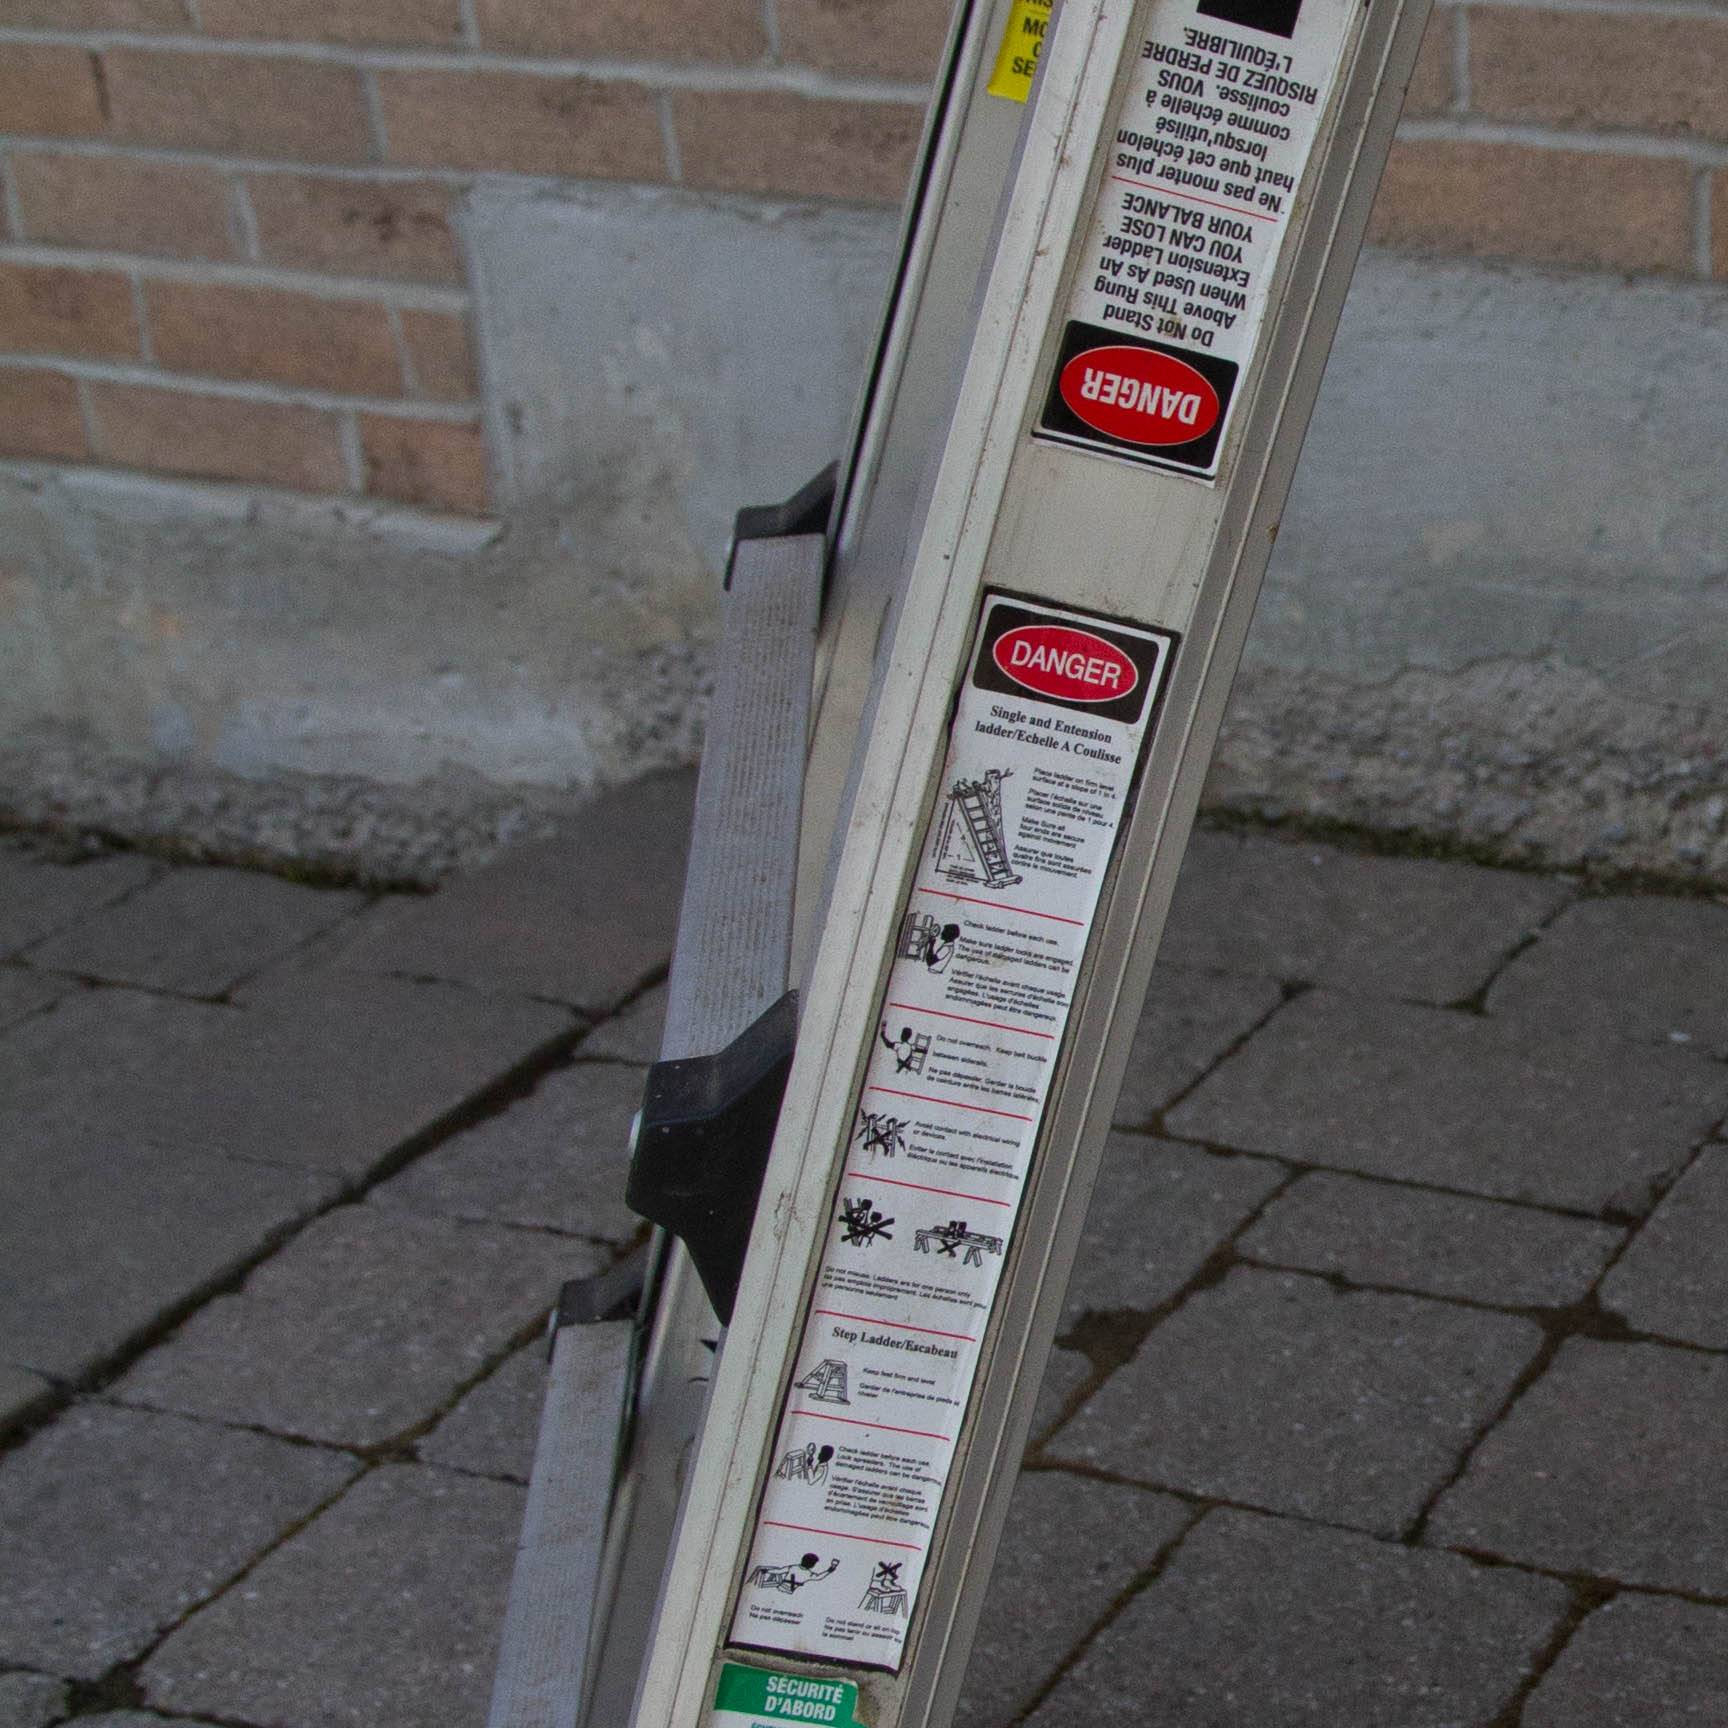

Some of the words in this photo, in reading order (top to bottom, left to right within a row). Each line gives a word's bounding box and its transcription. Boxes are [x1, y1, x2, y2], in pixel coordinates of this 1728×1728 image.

[1140, 39, 1213, 75] PERDRE
[1182, 26, 1293, 74] L'ÉQUILIBRE.
[1156, 68, 1204, 98] VOUS
[1214, 60, 1241, 83] DE
[1242, 68, 1318, 103] RISQUEZ
[1144, 88, 1157, 108] à
[1160, 93, 1223, 126] échelle
[1215, 84, 1290, 117] coulisse.
[1154, 115, 1268, 162] lorsqu'utilisé
[1226, 111, 1290, 141] comme
[1115, 128, 1184, 162] échelon
[1186, 148, 1216, 167] cet
[1115, 152, 1155, 175] plus
[1218, 157, 1252, 178] que
[1155, 164, 1220, 192] monter
[1222, 181, 1256, 202] pas
[1253, 166, 1294, 193] haut
[1120, 191, 1205, 229] BALANCE
[1257, 191, 1282, 213] Ne
[1119, 214, 1166, 242] LOSE
[1168, 228, 1206, 253] CAN
[1206, 215, 1252, 243] YOUR
[1101, 234, 1164, 265] Ladder
[1207, 239, 1242, 263] YOU
[1098, 255, 1124, 277] An
[1126, 263, 1151, 284] As
[1166, 250, 1250, 288] Extension
[1093, 275, 1139, 305] Rung
[1151, 270, 1196, 297] Used
[1199, 282, 1246, 310] When
[1101, 303, 1154, 331] Stand
[1142, 290, 1177, 316] This
[1182, 301, 1237, 329] Above
[1155, 317, 1187, 340] Not
[1190, 326, 1214, 347] Do
[1080, 367, 1201, 425] DANGER
[1010, 639, 1121, 689] DANGER
[989, 704, 1027, 724] Single
[1028, 716, 1052, 729] and
[1060, 740, 1070, 752] A
[1072, 742, 1121, 764] Coulisse
[831, 1326, 858, 1343] Step
[766, 1674, 846, 1704] SÉCURITÉ
[764, 1695, 835, 1720] D'ABORD
